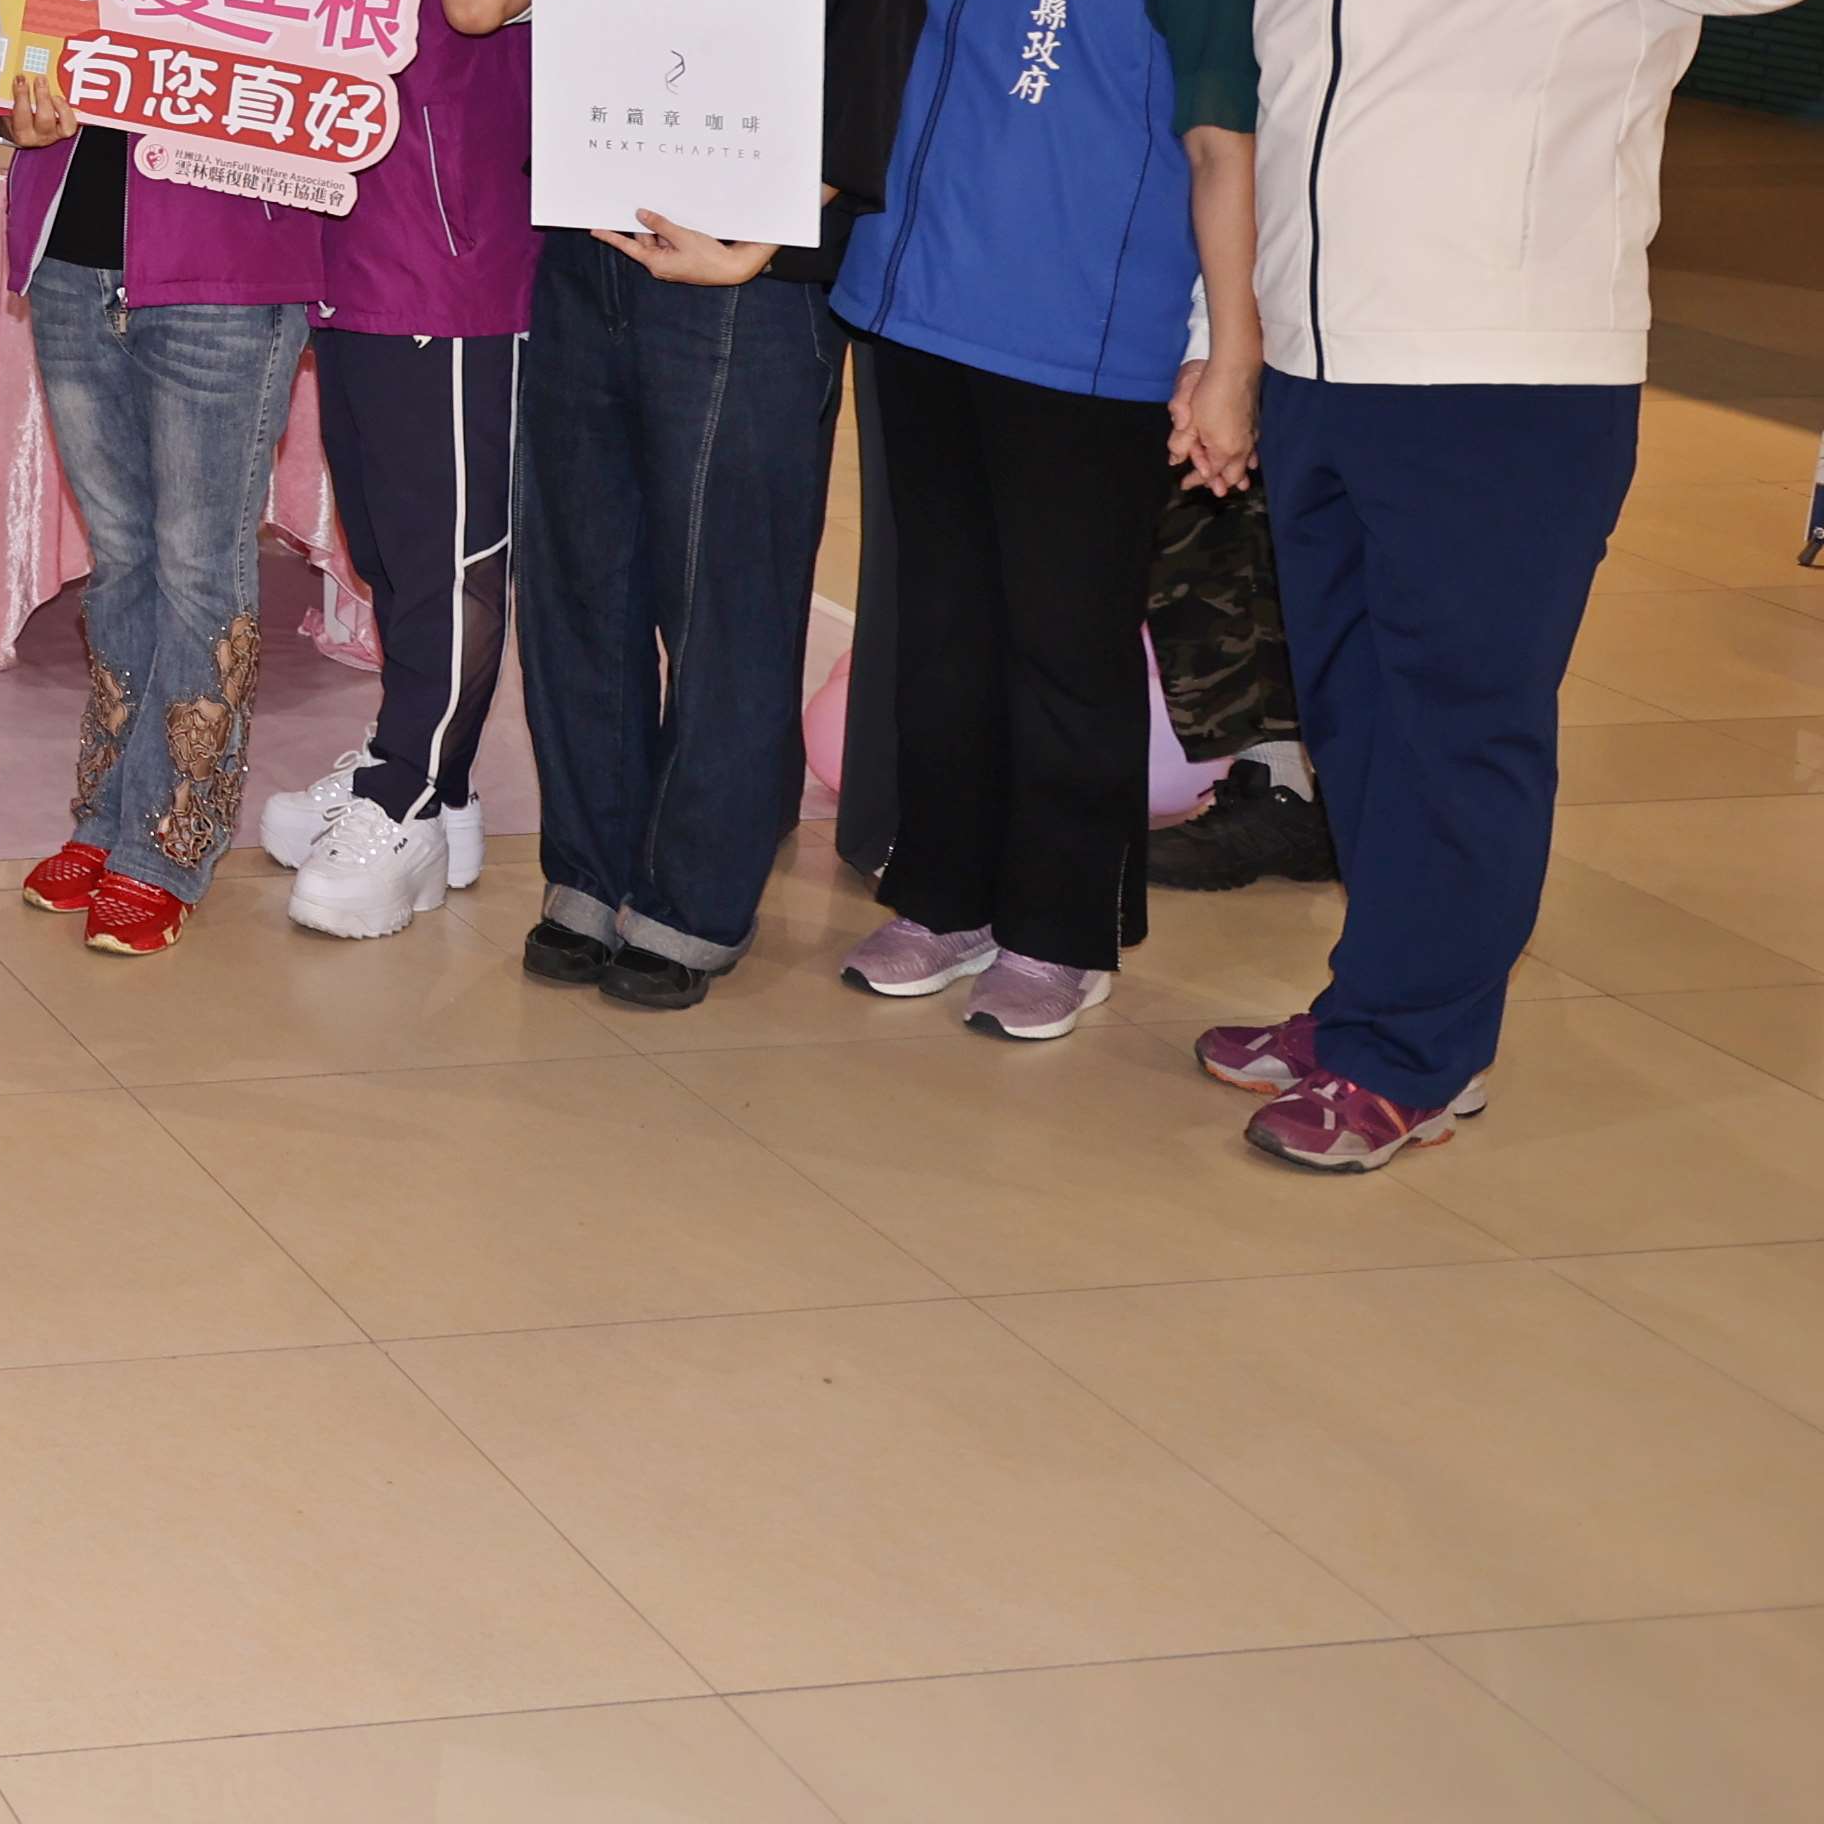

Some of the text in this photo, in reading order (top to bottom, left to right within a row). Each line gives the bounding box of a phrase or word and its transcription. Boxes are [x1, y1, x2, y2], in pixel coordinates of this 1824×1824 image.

[61, 33, 387, 160] 有您真好
[589, 139, 760, 159] NEXT CHAPTER
[215, 158, 251, 172] YunFull
[252, 165, 288, 178] Welfare
[290, 172, 345, 190] Association
